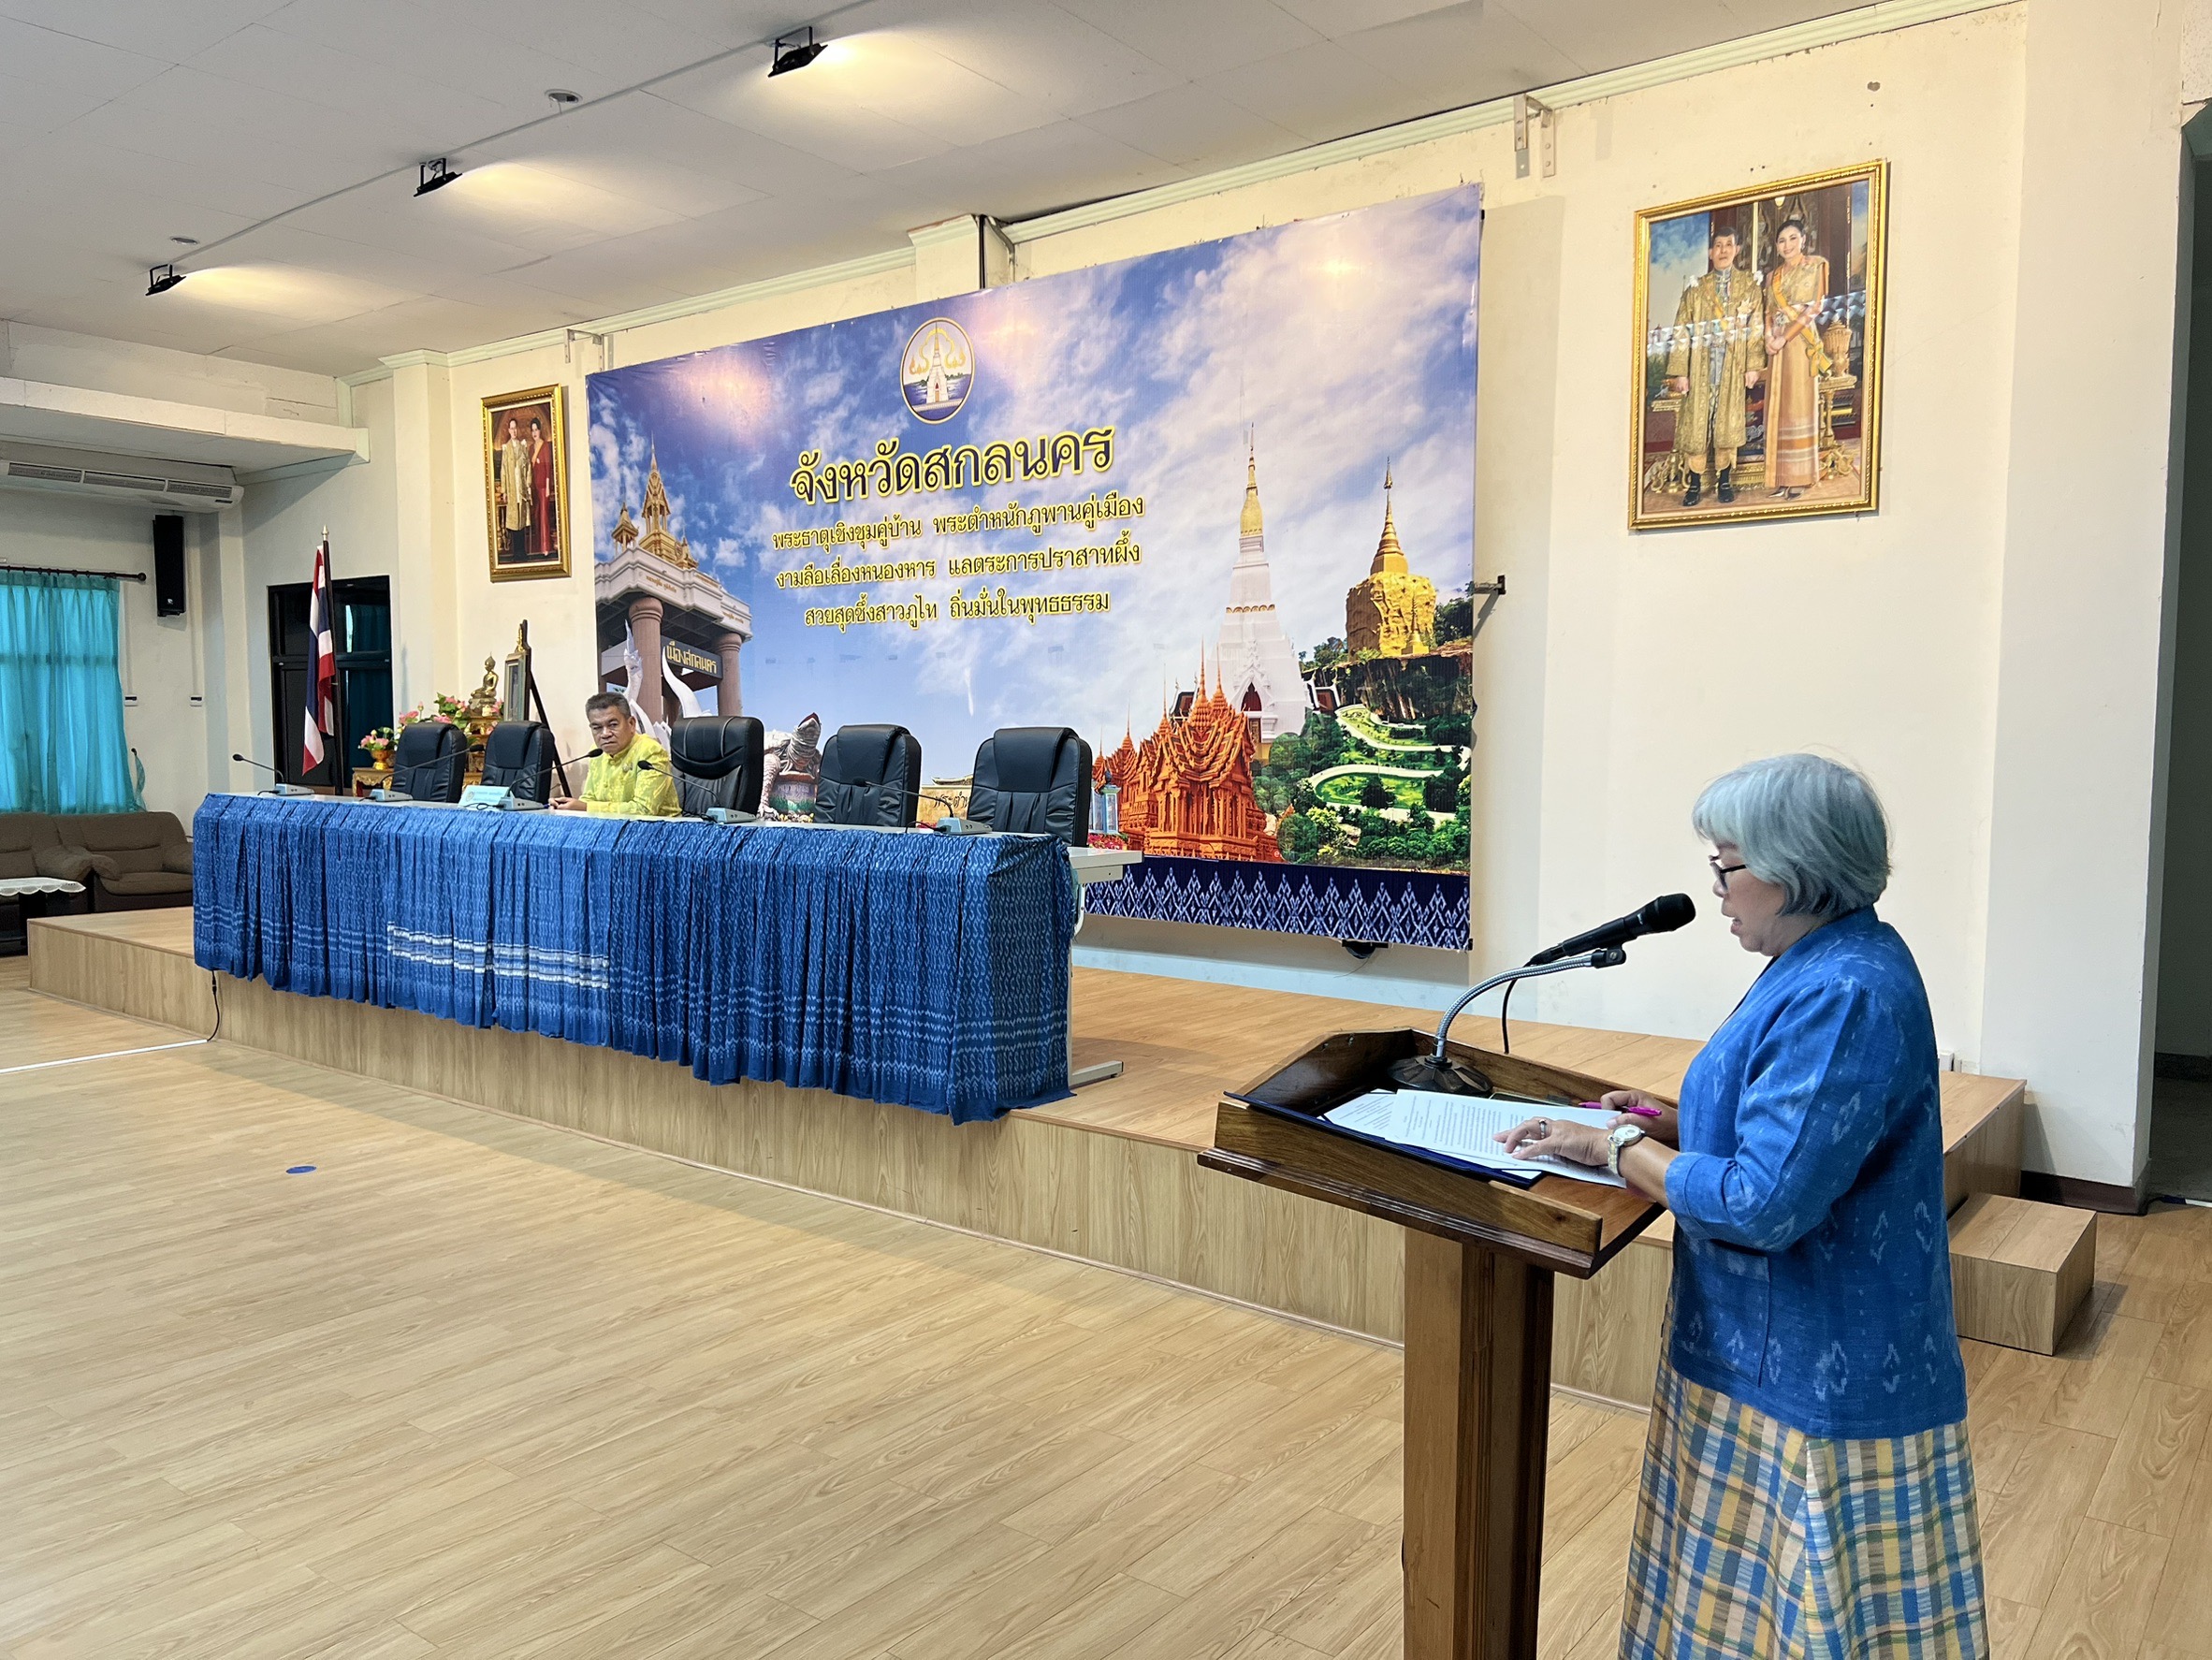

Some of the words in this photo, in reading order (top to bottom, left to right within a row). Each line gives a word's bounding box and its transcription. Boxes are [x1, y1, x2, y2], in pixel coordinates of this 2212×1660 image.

[791, 426, 1114, 505] จังหวัดสกลนคร
[772, 513, 923, 554] พระธาตุเชิงชุมคู่บ้าน
[933, 489, 1144, 535] พระตำหนักภูพานคู่เมือง
[776, 556, 936, 589] งามลือเลื่องหนองหาร
[948, 530, 1142, 576] แลตระการปราสาทผึ้ง
[805, 592, 938, 633] สวยสุดซึ้งสาวภูไท
[950, 586, 1111, 624] ถิ่นมั่นในพุทธธรรม
